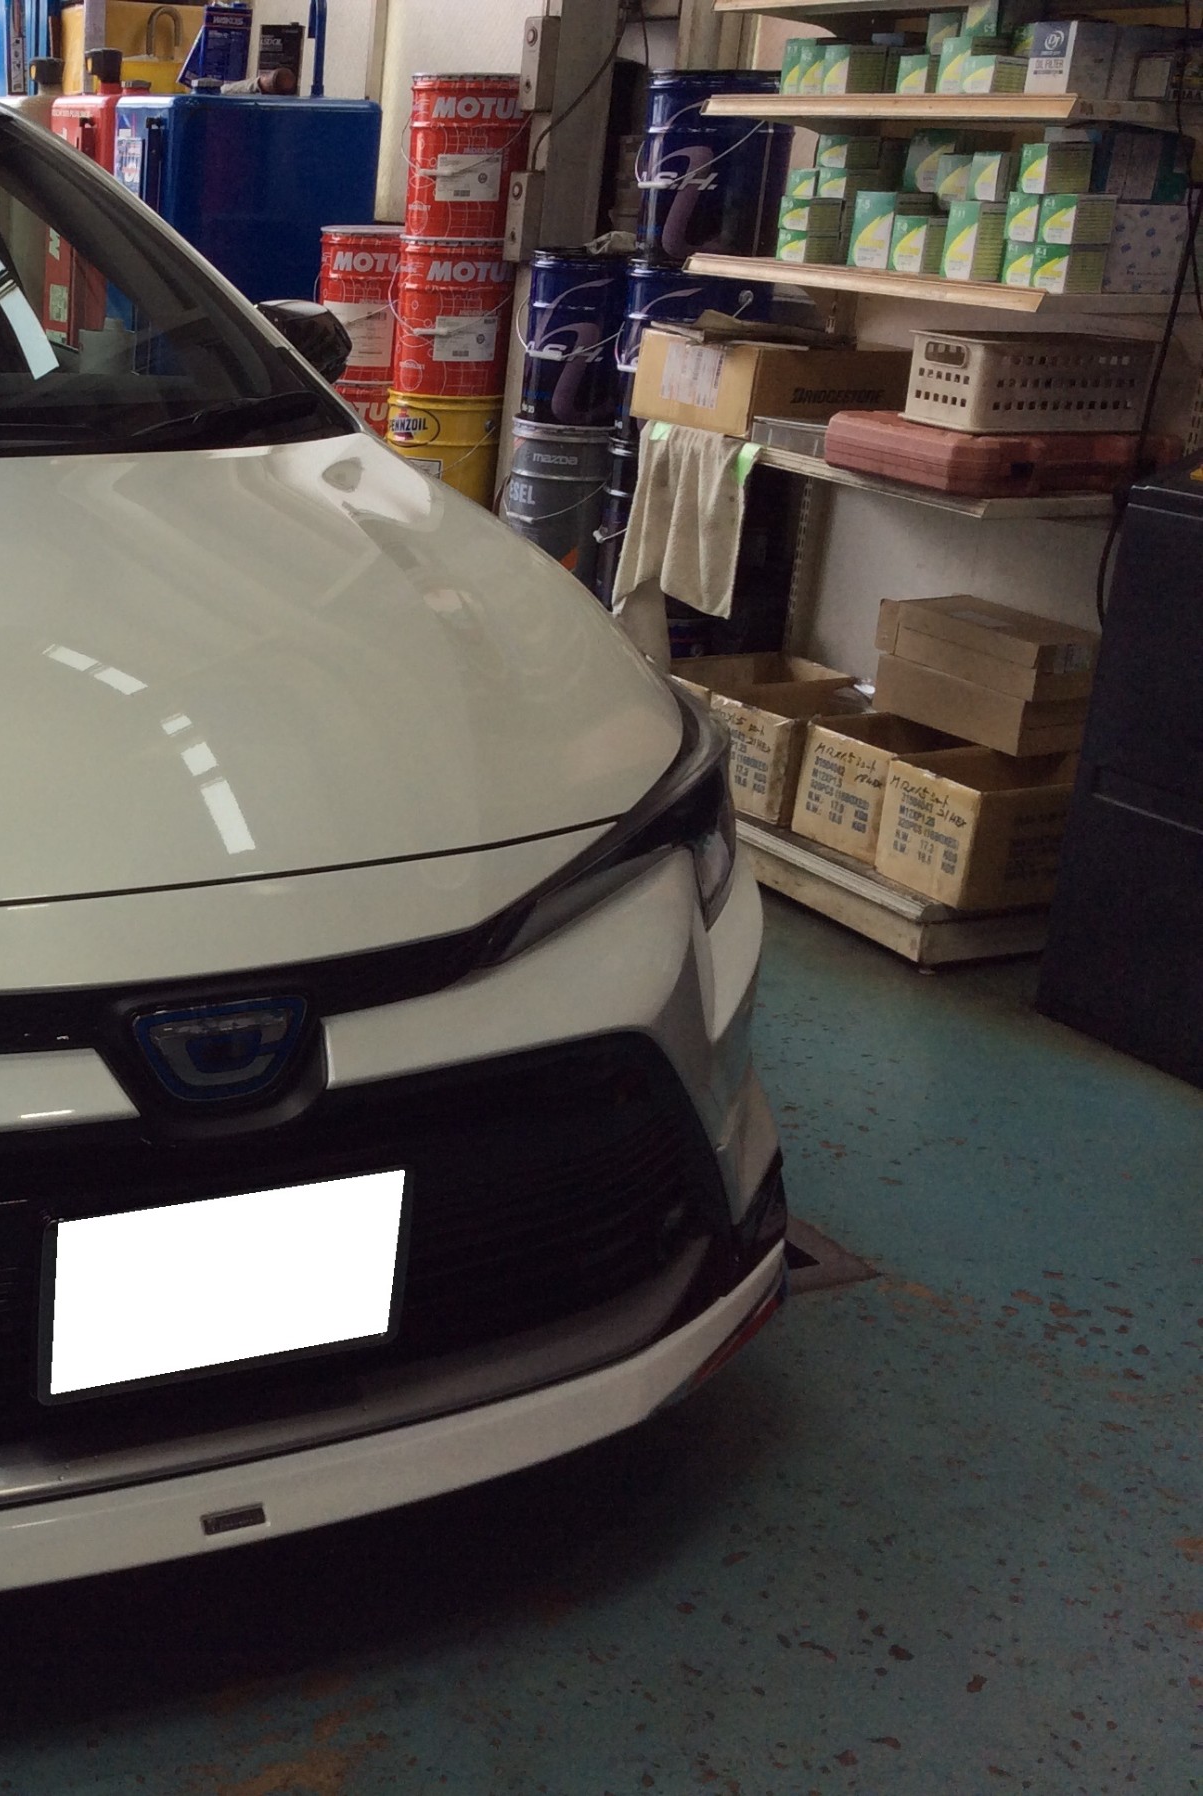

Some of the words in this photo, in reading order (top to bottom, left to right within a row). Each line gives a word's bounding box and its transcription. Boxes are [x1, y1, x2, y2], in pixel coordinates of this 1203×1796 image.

[333, 251, 399, 273] MOTU
[790, 386, 886, 405] BRIDGESTONE
[509, 479, 536, 505] ESEL
